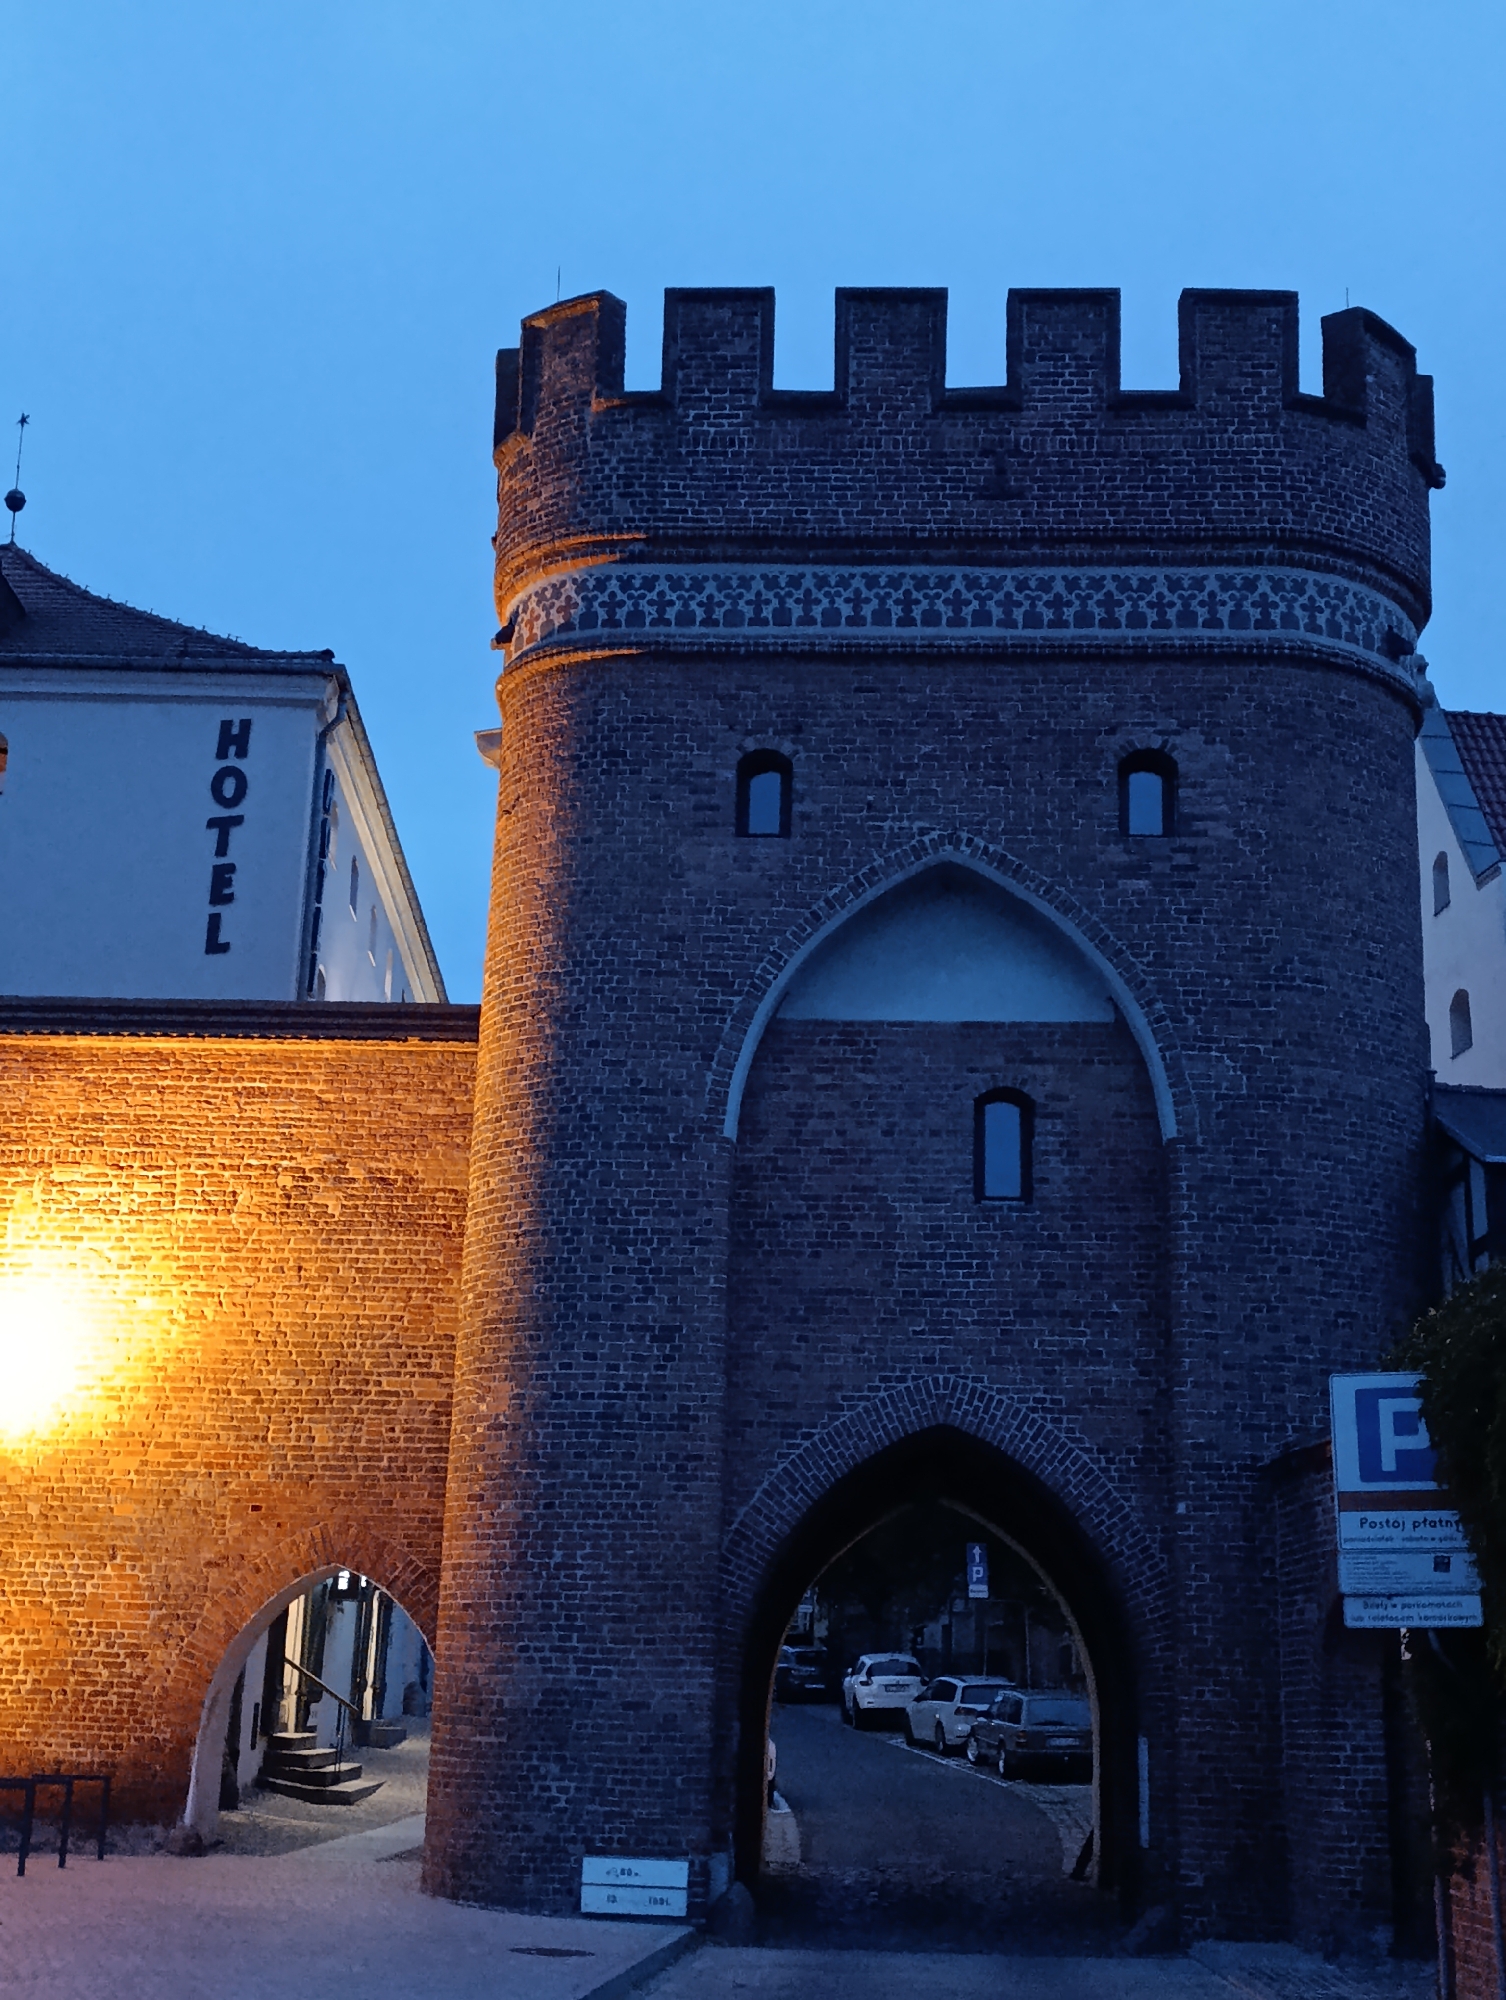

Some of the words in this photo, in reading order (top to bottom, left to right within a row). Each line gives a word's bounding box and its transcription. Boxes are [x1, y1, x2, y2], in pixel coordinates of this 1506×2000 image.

[205, 718, 252, 955] HOTEL
[1377, 1397, 1431, 1472] P
[972, 1566, 984, 1583] P
